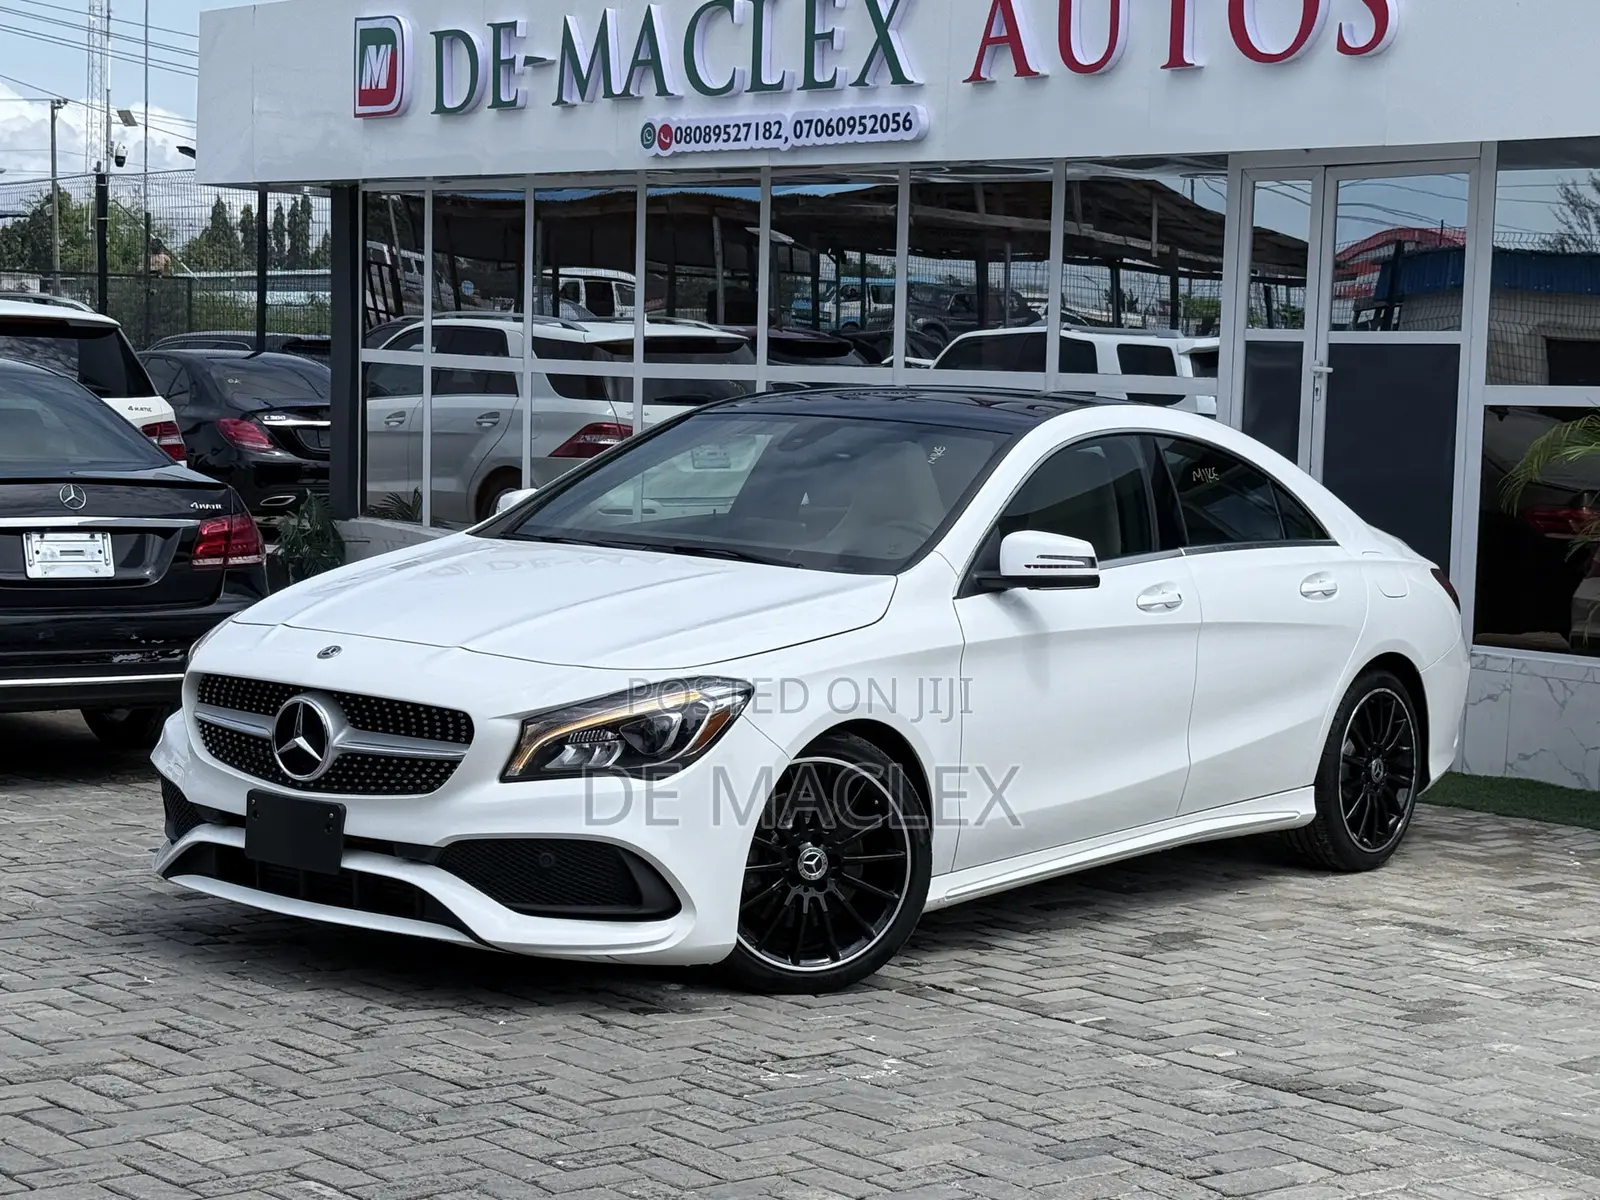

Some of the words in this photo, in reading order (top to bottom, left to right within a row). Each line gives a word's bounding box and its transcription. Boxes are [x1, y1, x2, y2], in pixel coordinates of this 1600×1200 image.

[429, 0, 922, 114] DE-MACLEX
[674, 119, 789, 145] 08089527182,
[793, 112, 913, 140] 07060952056
